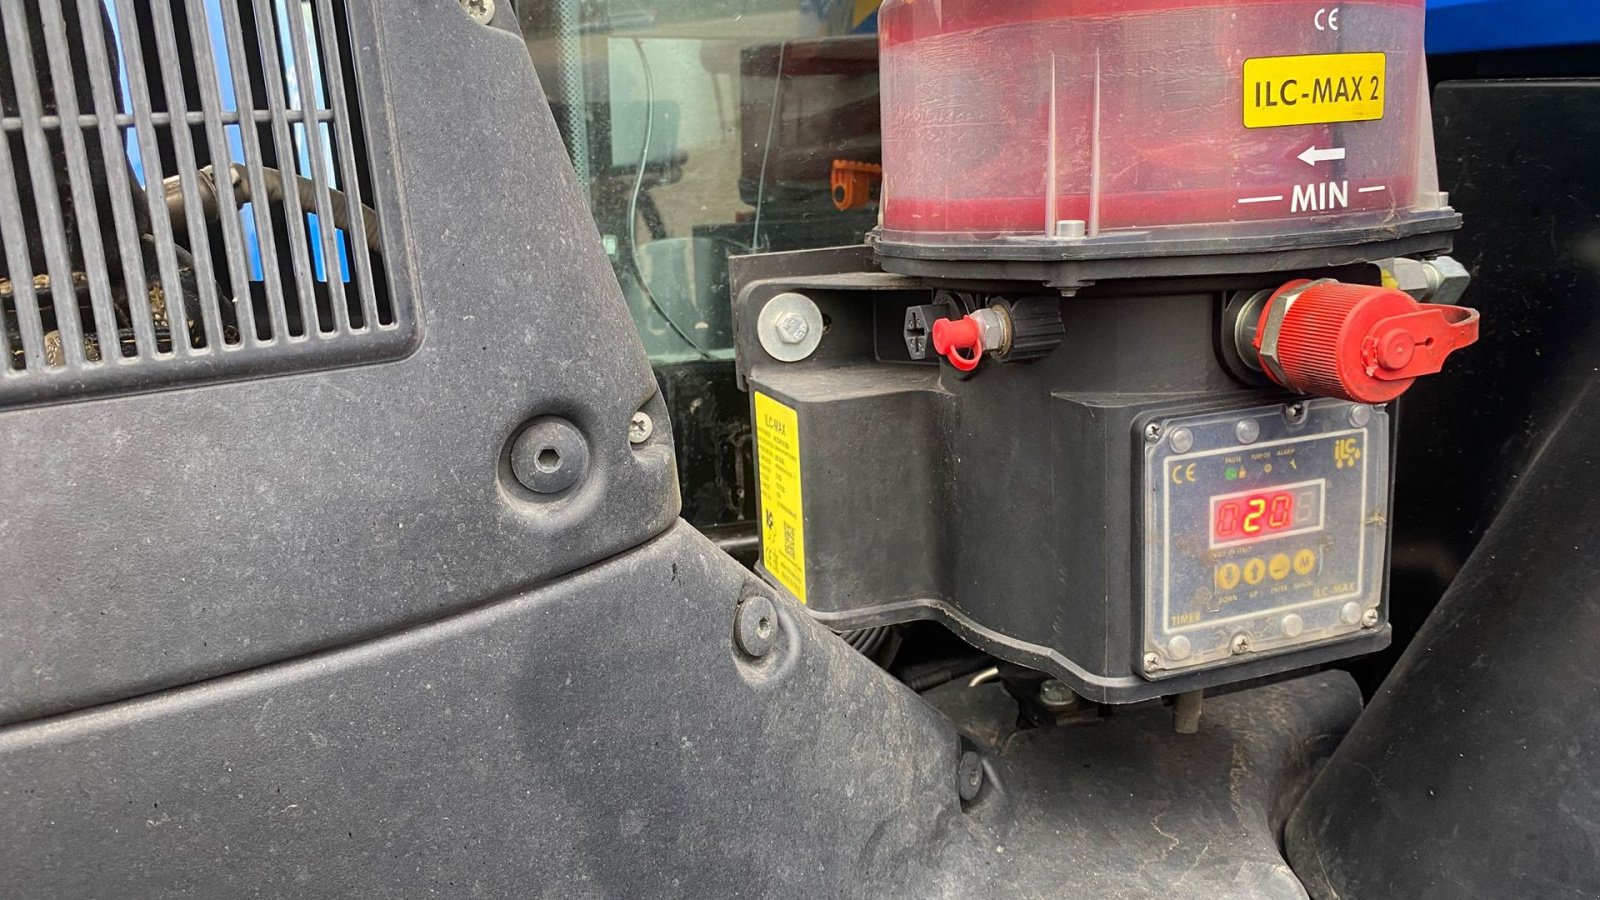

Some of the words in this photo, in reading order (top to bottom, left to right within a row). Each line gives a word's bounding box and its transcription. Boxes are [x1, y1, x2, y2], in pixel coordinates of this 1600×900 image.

[1314, 8, 1339, 31] CE
[1255, 76, 1363, 107] ILC-MAX
[1370, 75, 1379, 101] 2
[1290, 180, 1348, 213] MIN
[1172, 463, 1196, 484] CE
[1171, 612, 1201, 625] TIMER
